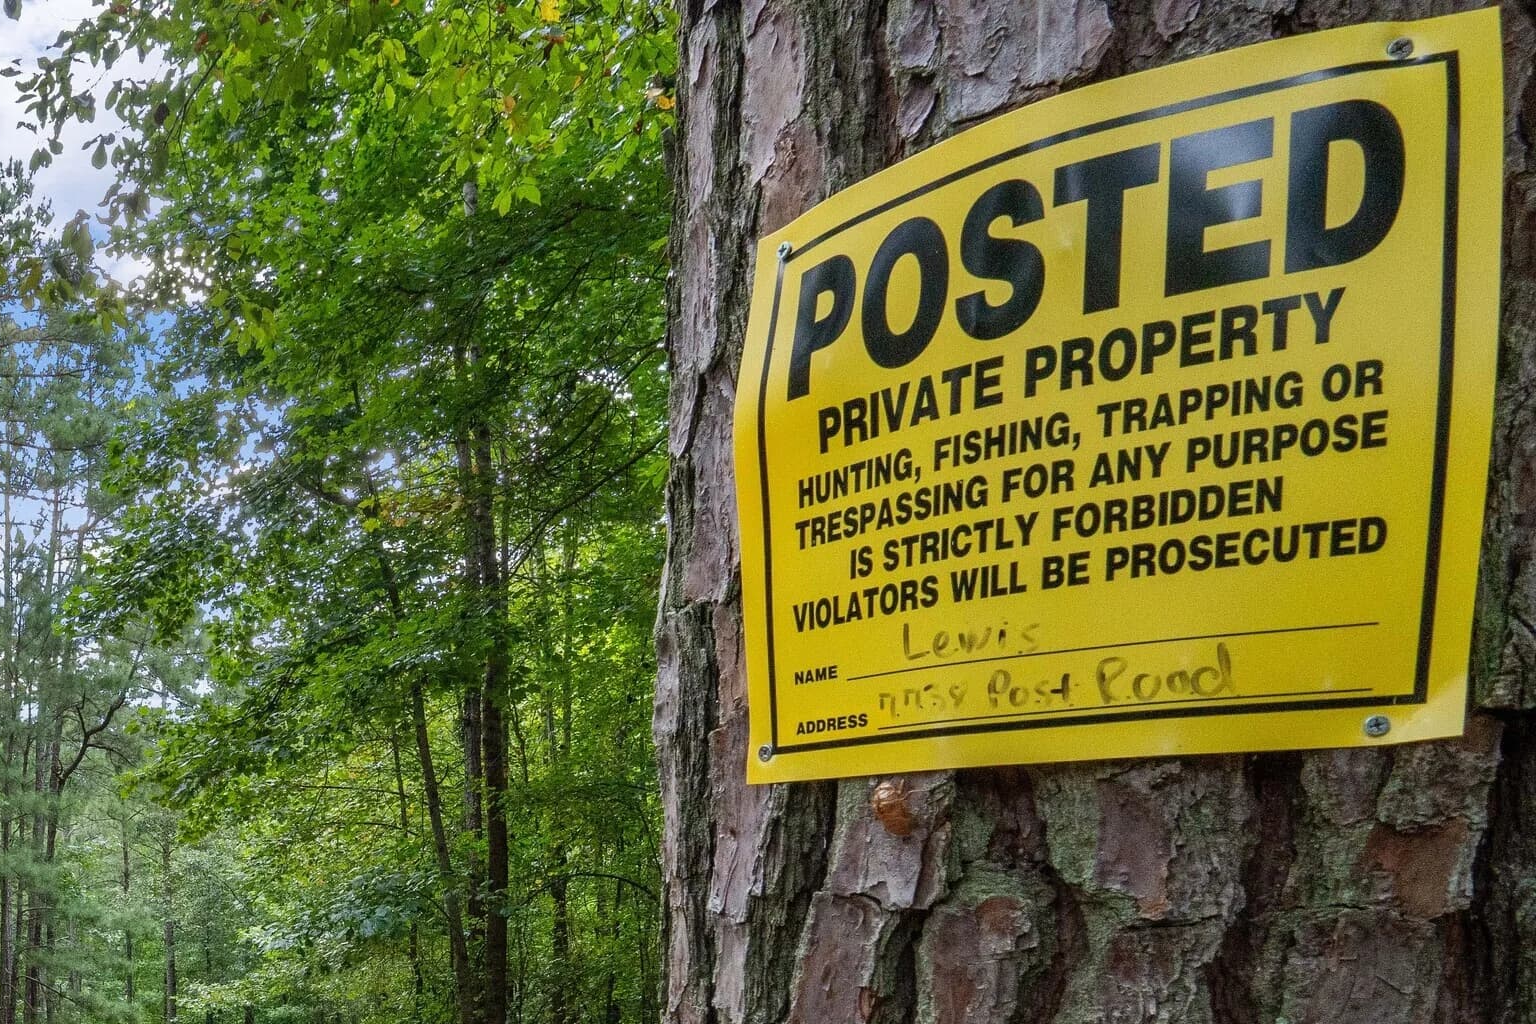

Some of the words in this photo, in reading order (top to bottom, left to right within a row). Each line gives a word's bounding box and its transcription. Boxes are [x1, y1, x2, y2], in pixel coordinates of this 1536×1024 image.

[787, 98, 1406, 400] POSTED
[818, 356, 1004, 454] PRIVATE
[1024, 288, 1346, 398] PROPERTY
[795, 479, 989, 550] TRESPASSING
[1000, 459, 1075, 501] FOR
[1090, 442, 1172, 486] ANY
[1185, 410, 1389, 472] PURPOSE
[798, 448, 923, 509] HUNTING,
[933, 412, 1082, 486] FISHING,
[1096, 372, 1304, 432] TRAPPING
[1320, 359, 1385, 399] OR
[793, 572, 939, 632] VIOLATORS
[949, 562, 1029, 601] WILL
[1041, 552, 1090, 589] BE
[1104, 516, 1388, 581] PROSECUTED
[849, 546, 875, 579] IS
[882, 512, 1038, 572] STRICTLY
[1052, 476, 1284, 542] FORBIDDEN
[794, 665, 838, 684] NAME
[902, 621, 1040, 661] Lewis
[795, 713, 868, 736] ADDRESS
